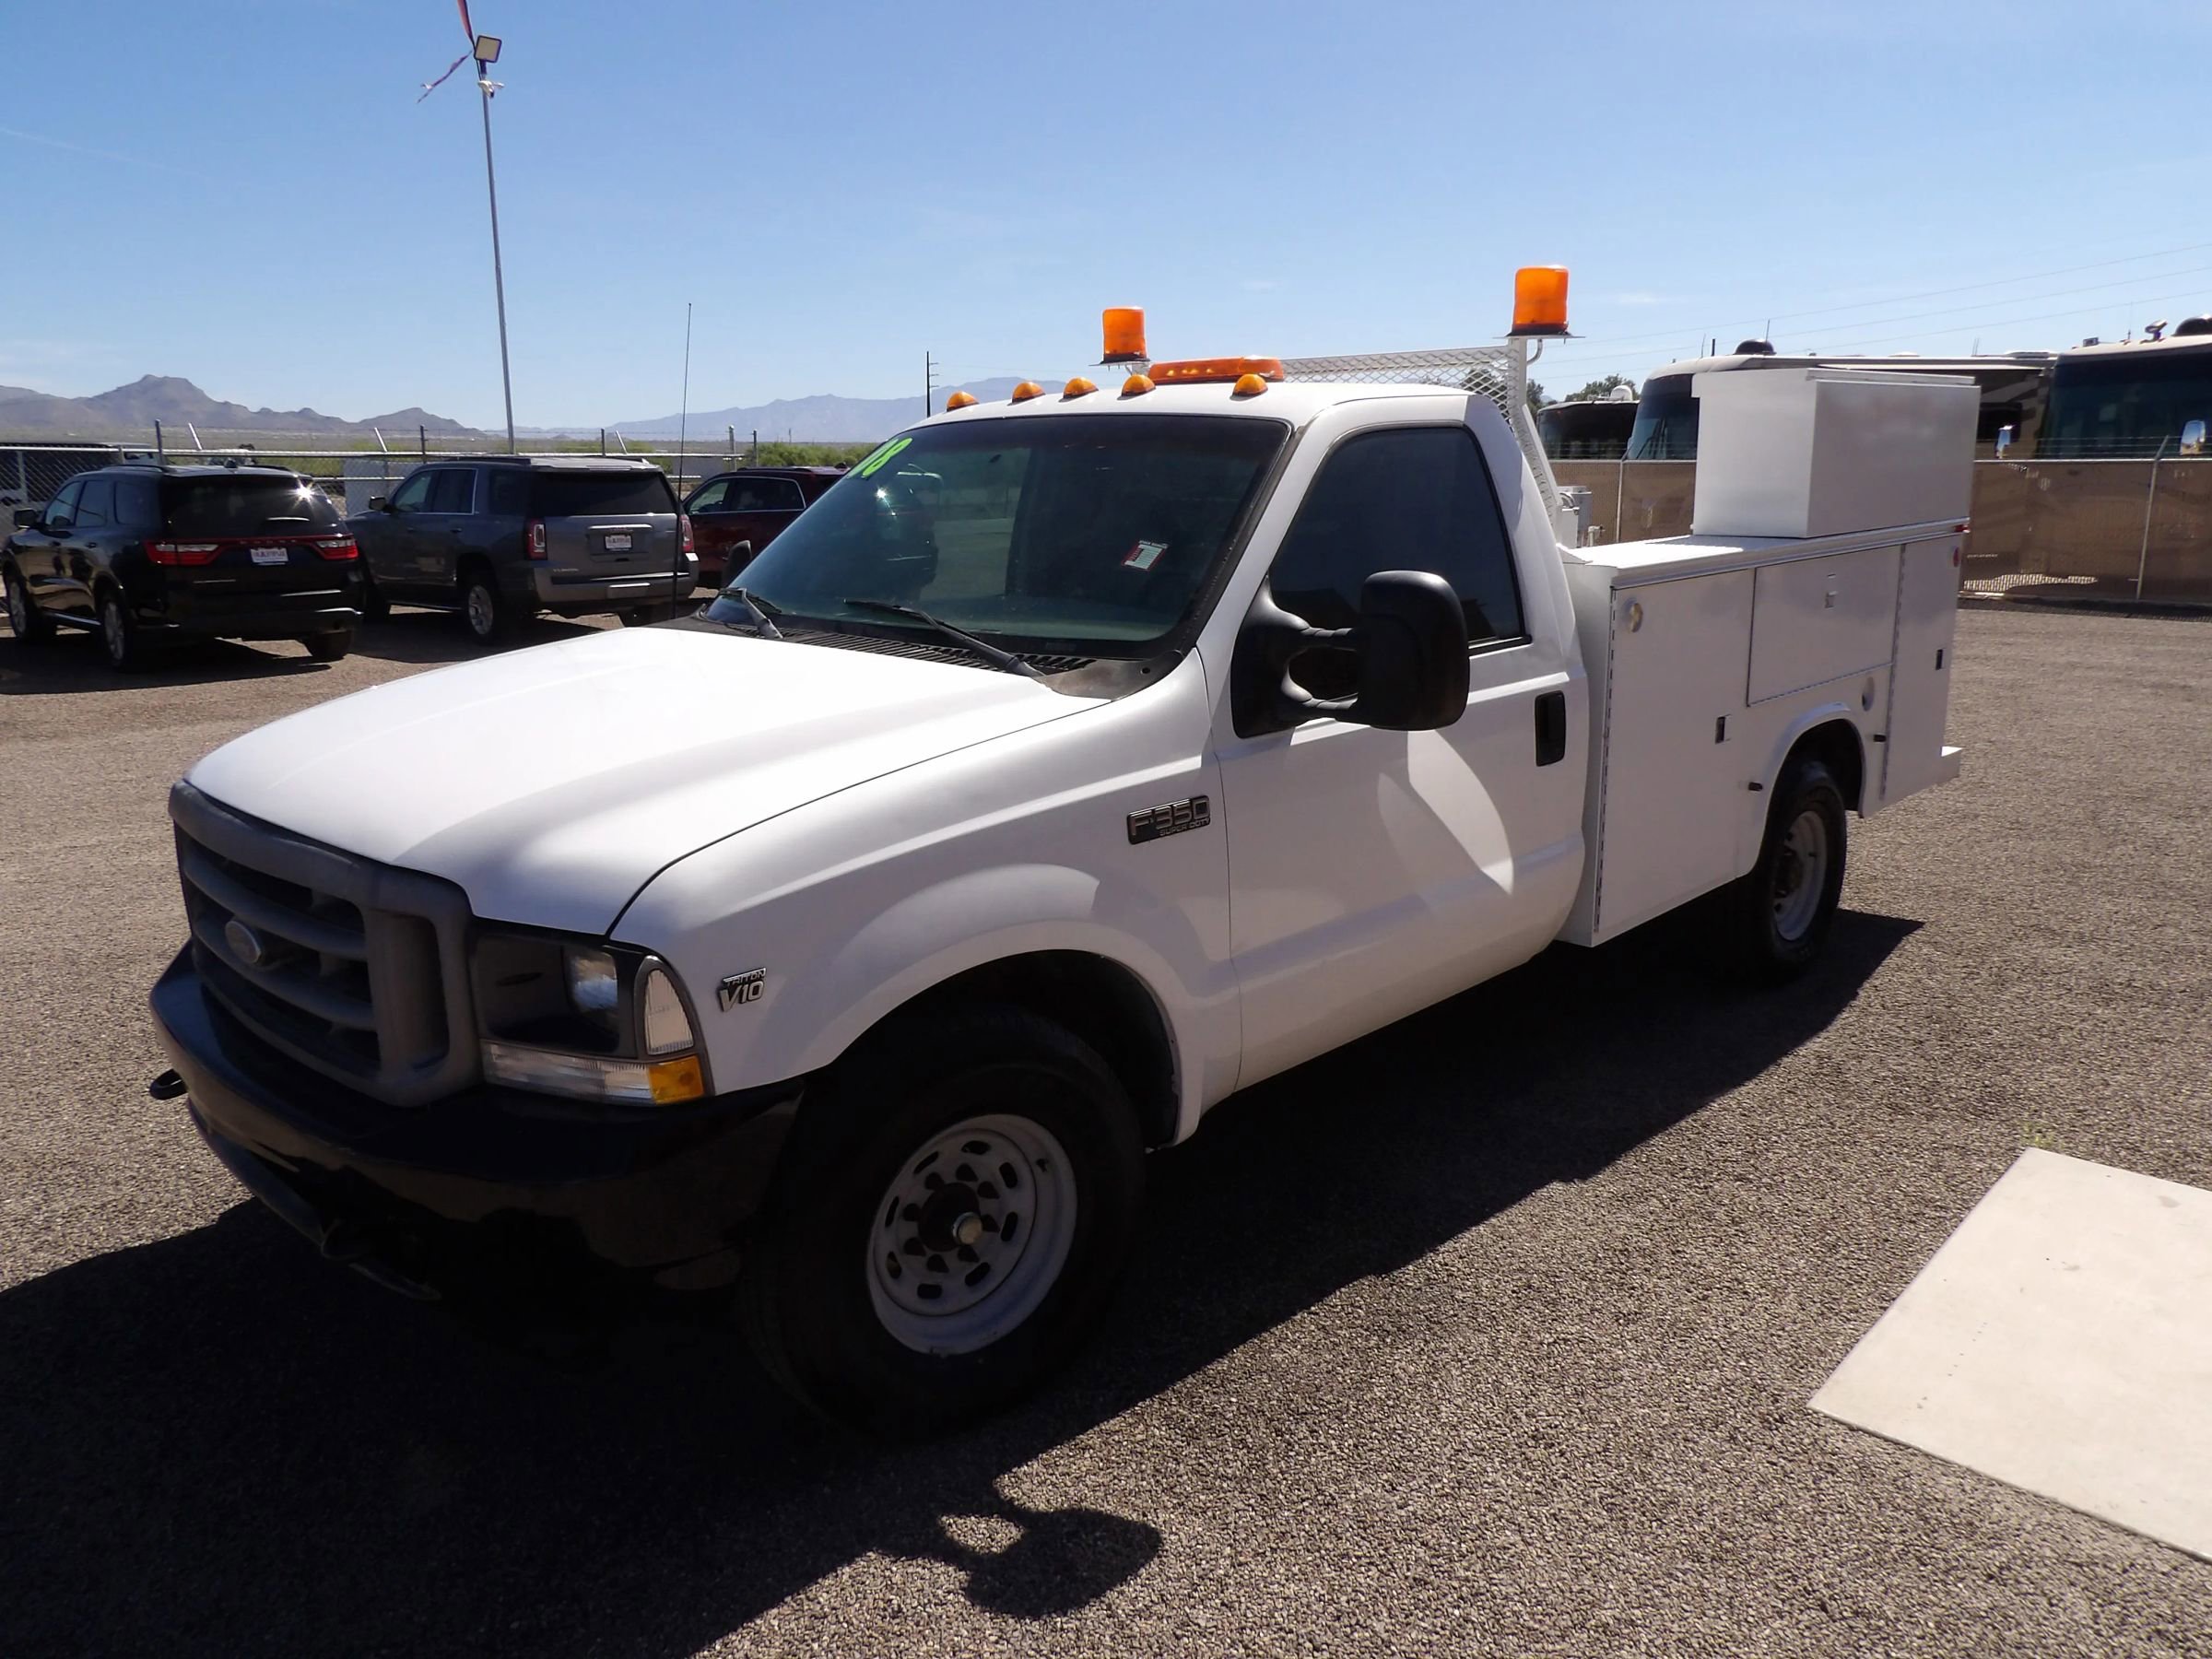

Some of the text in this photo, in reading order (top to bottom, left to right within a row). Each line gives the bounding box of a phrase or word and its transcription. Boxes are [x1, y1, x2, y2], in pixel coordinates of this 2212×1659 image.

[1159, 824, 1187, 836] SUPER
[724, 969, 766, 985] TRITON
[720, 981, 764, 1012] V10
